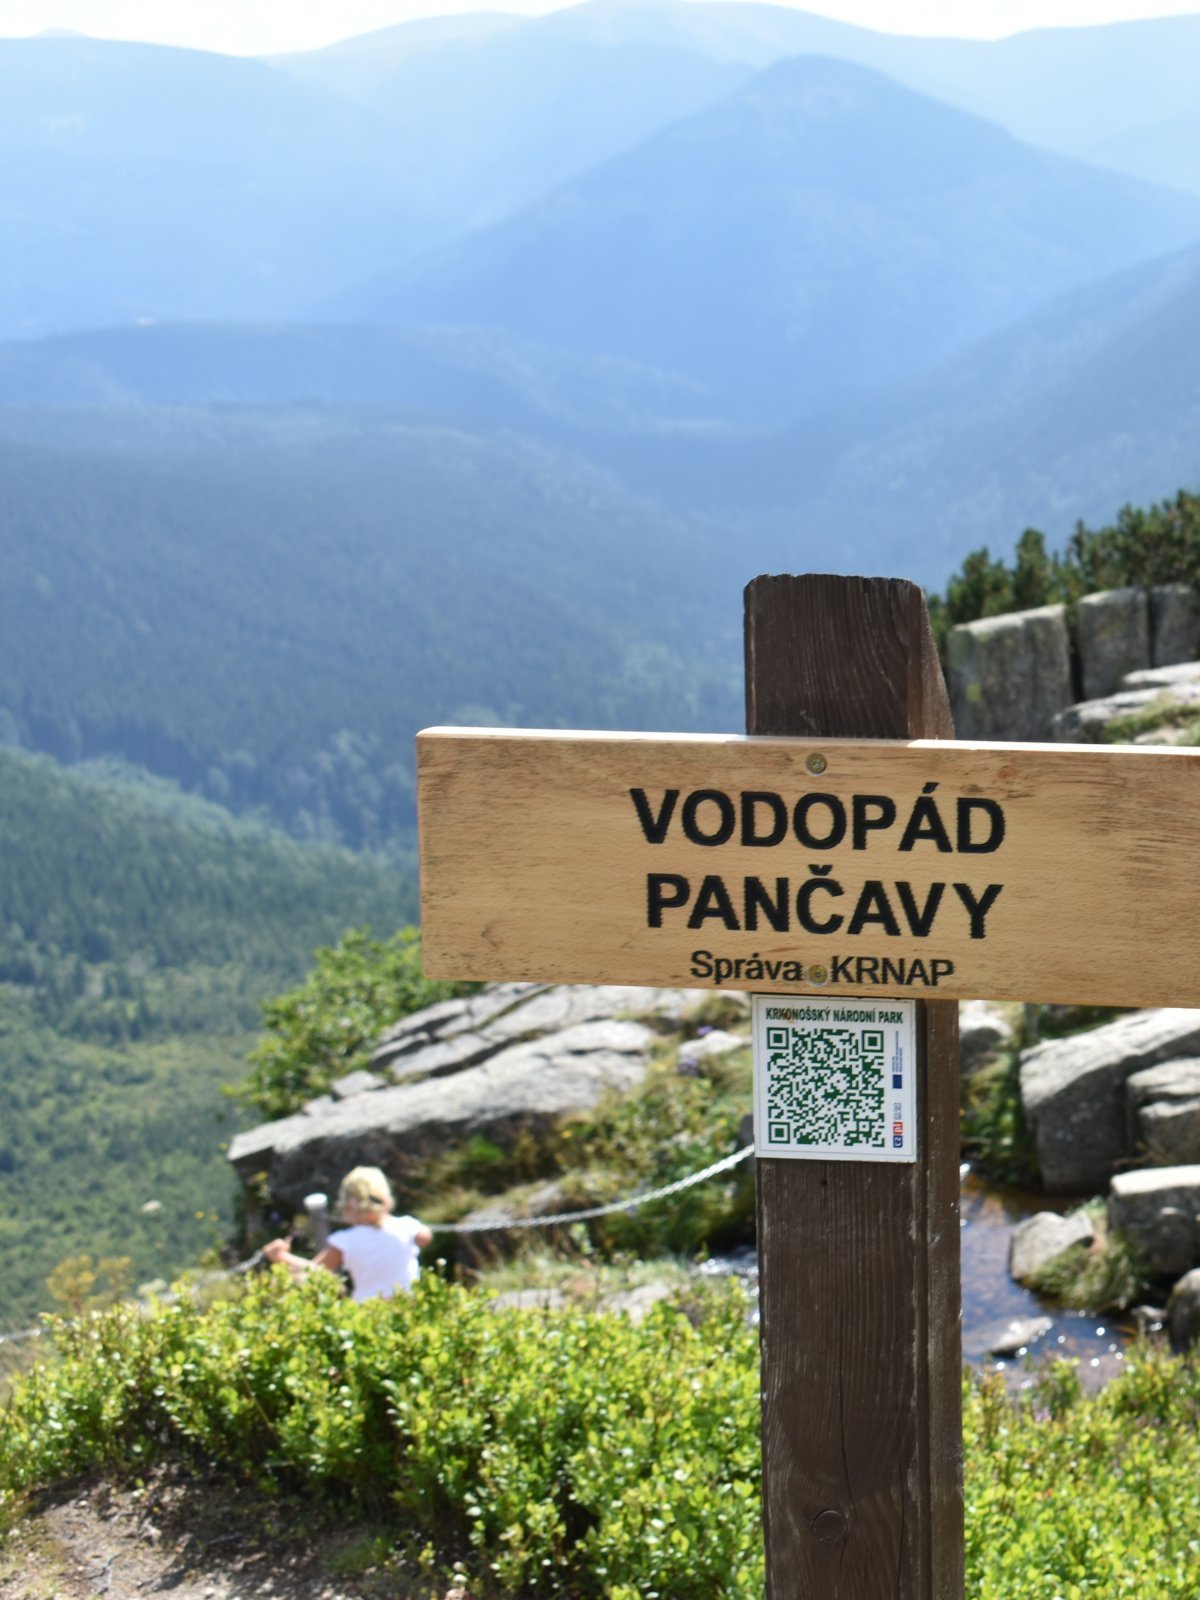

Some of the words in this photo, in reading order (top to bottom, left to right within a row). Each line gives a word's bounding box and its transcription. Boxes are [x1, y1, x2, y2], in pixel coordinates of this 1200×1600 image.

[629, 782, 1005, 853] VODOPÁD
[647, 864, 1002, 939] PANČAVY
[691, 951, 801, 984] Správa
[831, 956, 954, 986] KRNAP
[765, 1007, 831, 1022] KRKONOŠSKÝ
[833, 1007, 876, 1023] NÁRODNÍ
[878, 1011, 903, 1024] PARK
